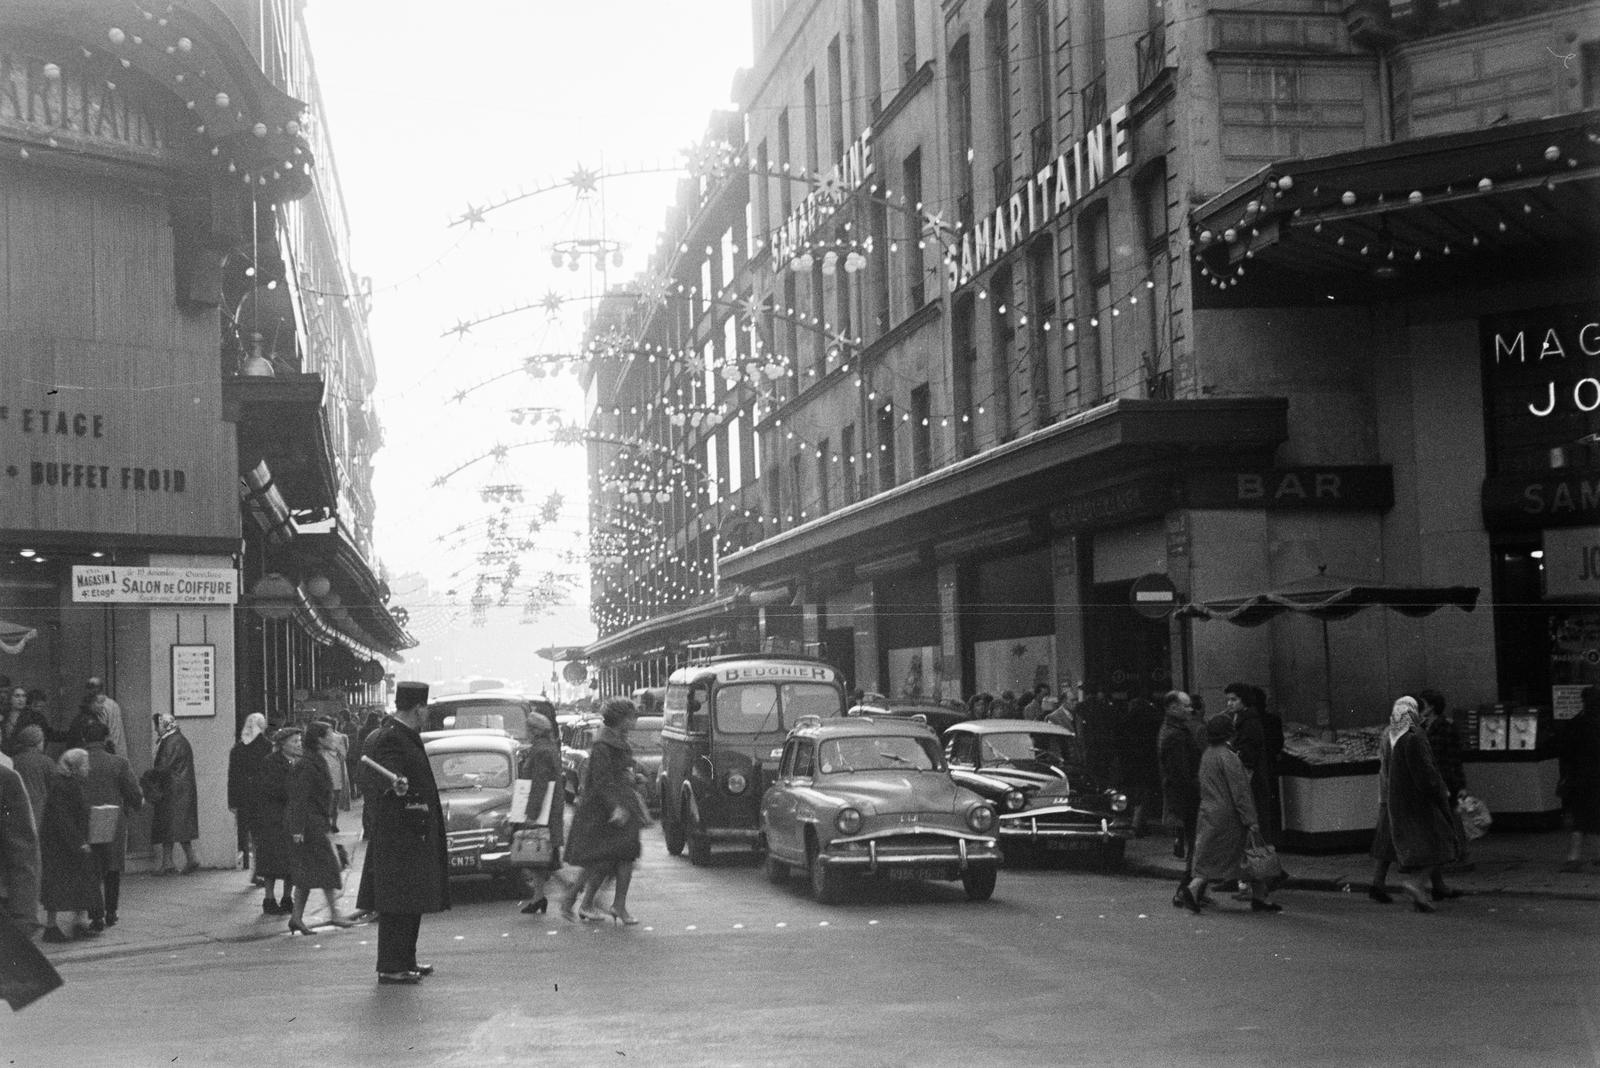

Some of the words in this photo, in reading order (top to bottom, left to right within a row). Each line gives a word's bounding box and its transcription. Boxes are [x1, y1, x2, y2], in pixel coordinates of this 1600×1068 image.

[949, 104, 1128, 292] SAMARITAINE
[1528, 377, 1600, 416] JO
[23, 408, 104, 438] ETAGE
[30, 462, 109, 489] BUFFET
[121, 467, 185, 492] FROID
[1237, 473, 1342, 499] BAR
[77, 574, 110, 587] MAGASIN
[111, 570, 117, 583] 1
[121, 577, 161, 593] SALON
[163, 584, 174, 593] DE
[177, 579, 231, 594] COIFFURE
[726, 666, 825, 681] BEUGNIER
